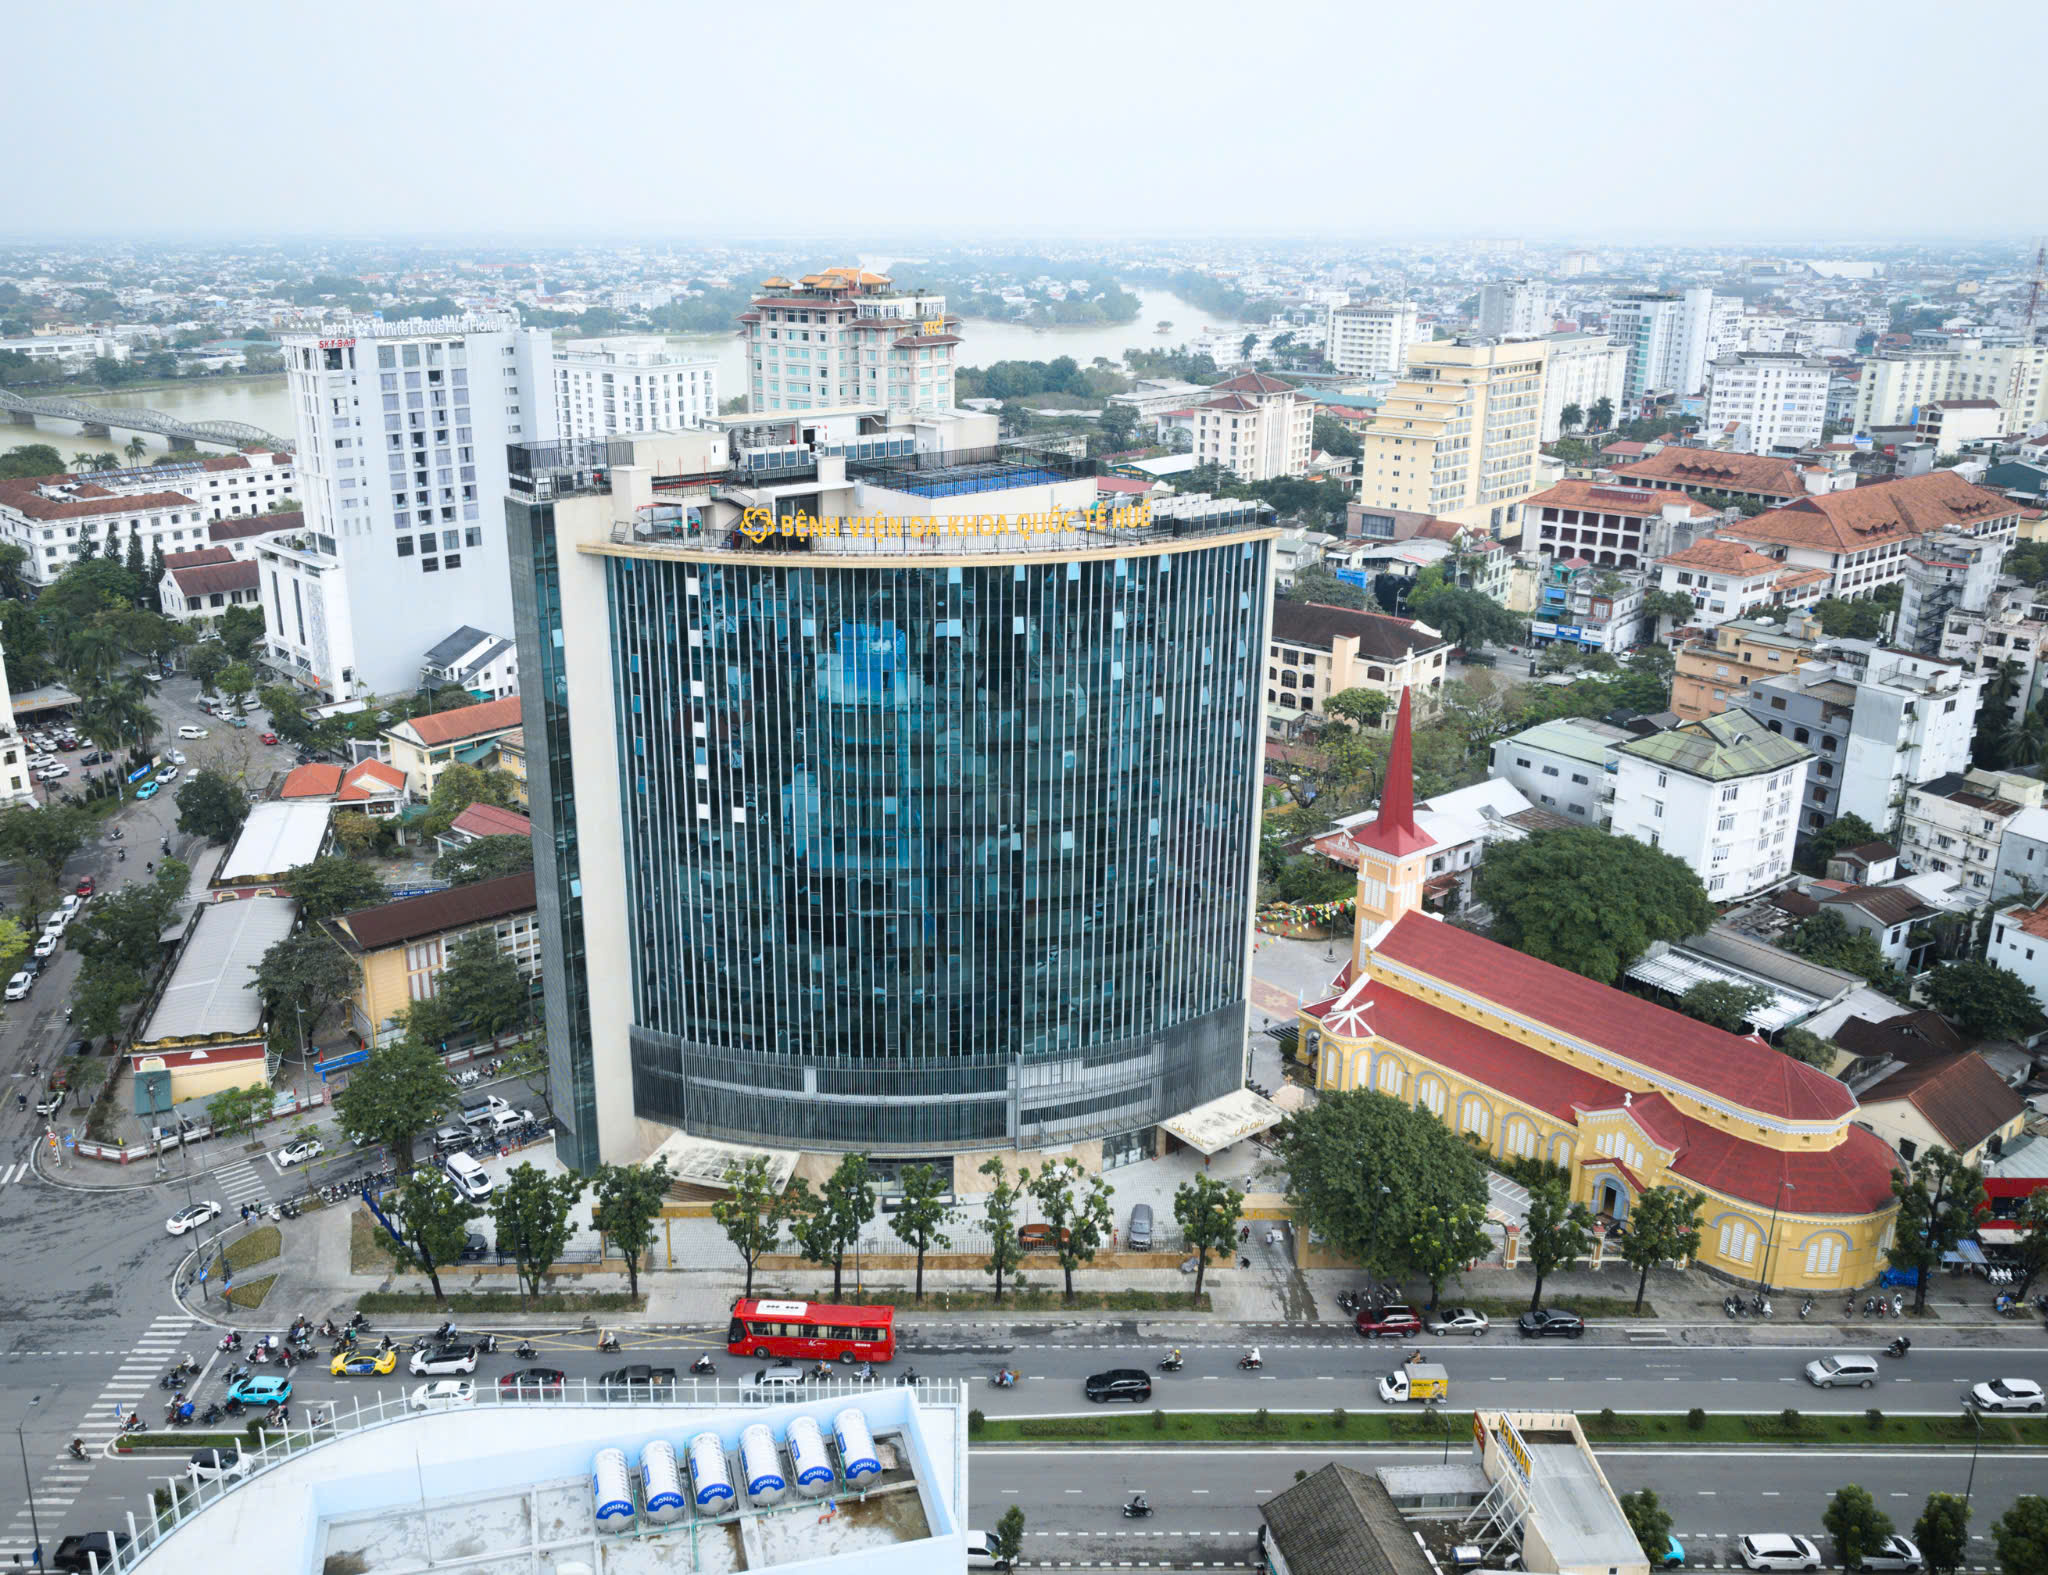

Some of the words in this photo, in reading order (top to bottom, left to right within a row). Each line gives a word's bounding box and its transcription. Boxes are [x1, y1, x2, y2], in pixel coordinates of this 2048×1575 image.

[410, 318, 444, 335] Lotus
[470, 319, 501, 333] Hotel
[319, 340, 335, 349] SKY
[337, 338, 356, 348] BAR
[781, 509, 840, 542] BỆNH
[847, 511, 903, 543] VIỆN
[910, 515, 941, 537] ĐA
[948, 514, 1009, 537] KHOA
[1016, 503, 1076, 540] QUỐC
[1082, 500, 1107, 531] TẾ
[1112, 498, 1152, 529] HUẾ
[852, 1462, 877, 1473] SONHA
[804, 1470, 829, 1481] SONHA
[755, 1480, 779, 1490] SONHA
[704, 1487, 727, 1498] SONHA
[653, 1495, 679, 1506] SONHA
[602, 1503, 628, 1515] SONHA
